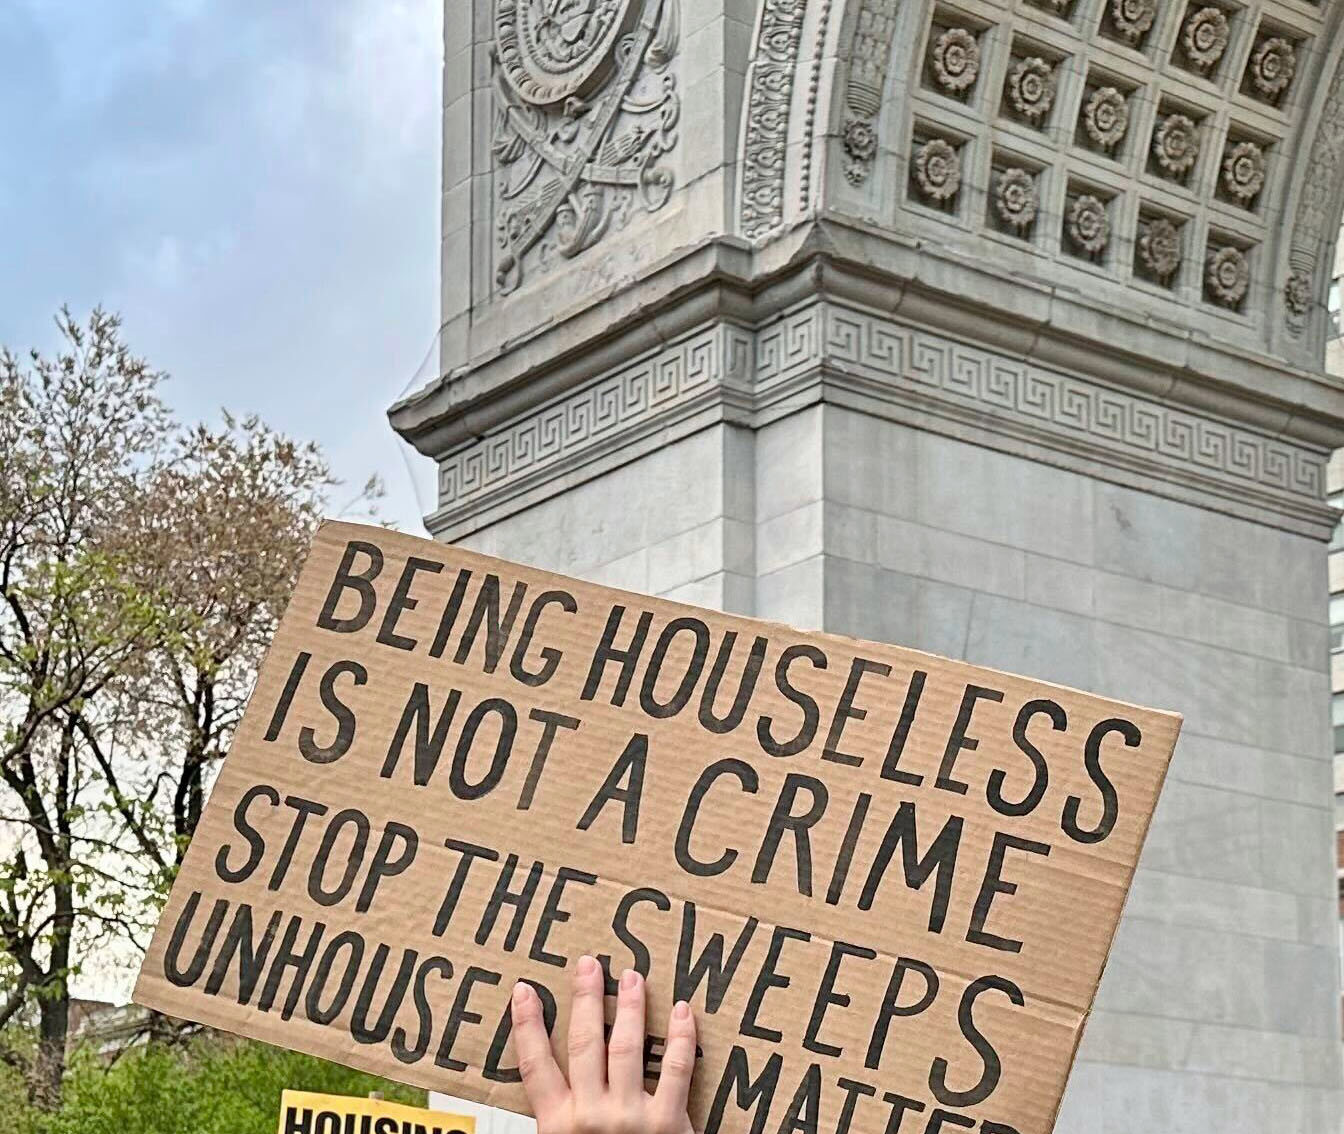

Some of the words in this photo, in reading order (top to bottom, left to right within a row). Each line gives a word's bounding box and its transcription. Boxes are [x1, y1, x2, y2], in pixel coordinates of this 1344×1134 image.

[263, 651, 368, 765] IS
[380, 683, 583, 811] NOT
[575, 733, 650, 844] A
[674, 758, 1052, 954] CRIME
[316, 540, 577, 687] BEING
[580, 604, 1142, 844] HOUSELESS
[163, 890, 558, 1083] UNHOUSED
[215, 785, 419, 913] STOP
[431, 838, 599, 969] THE
[597, 887, 1026, 1108] SWEEPS
